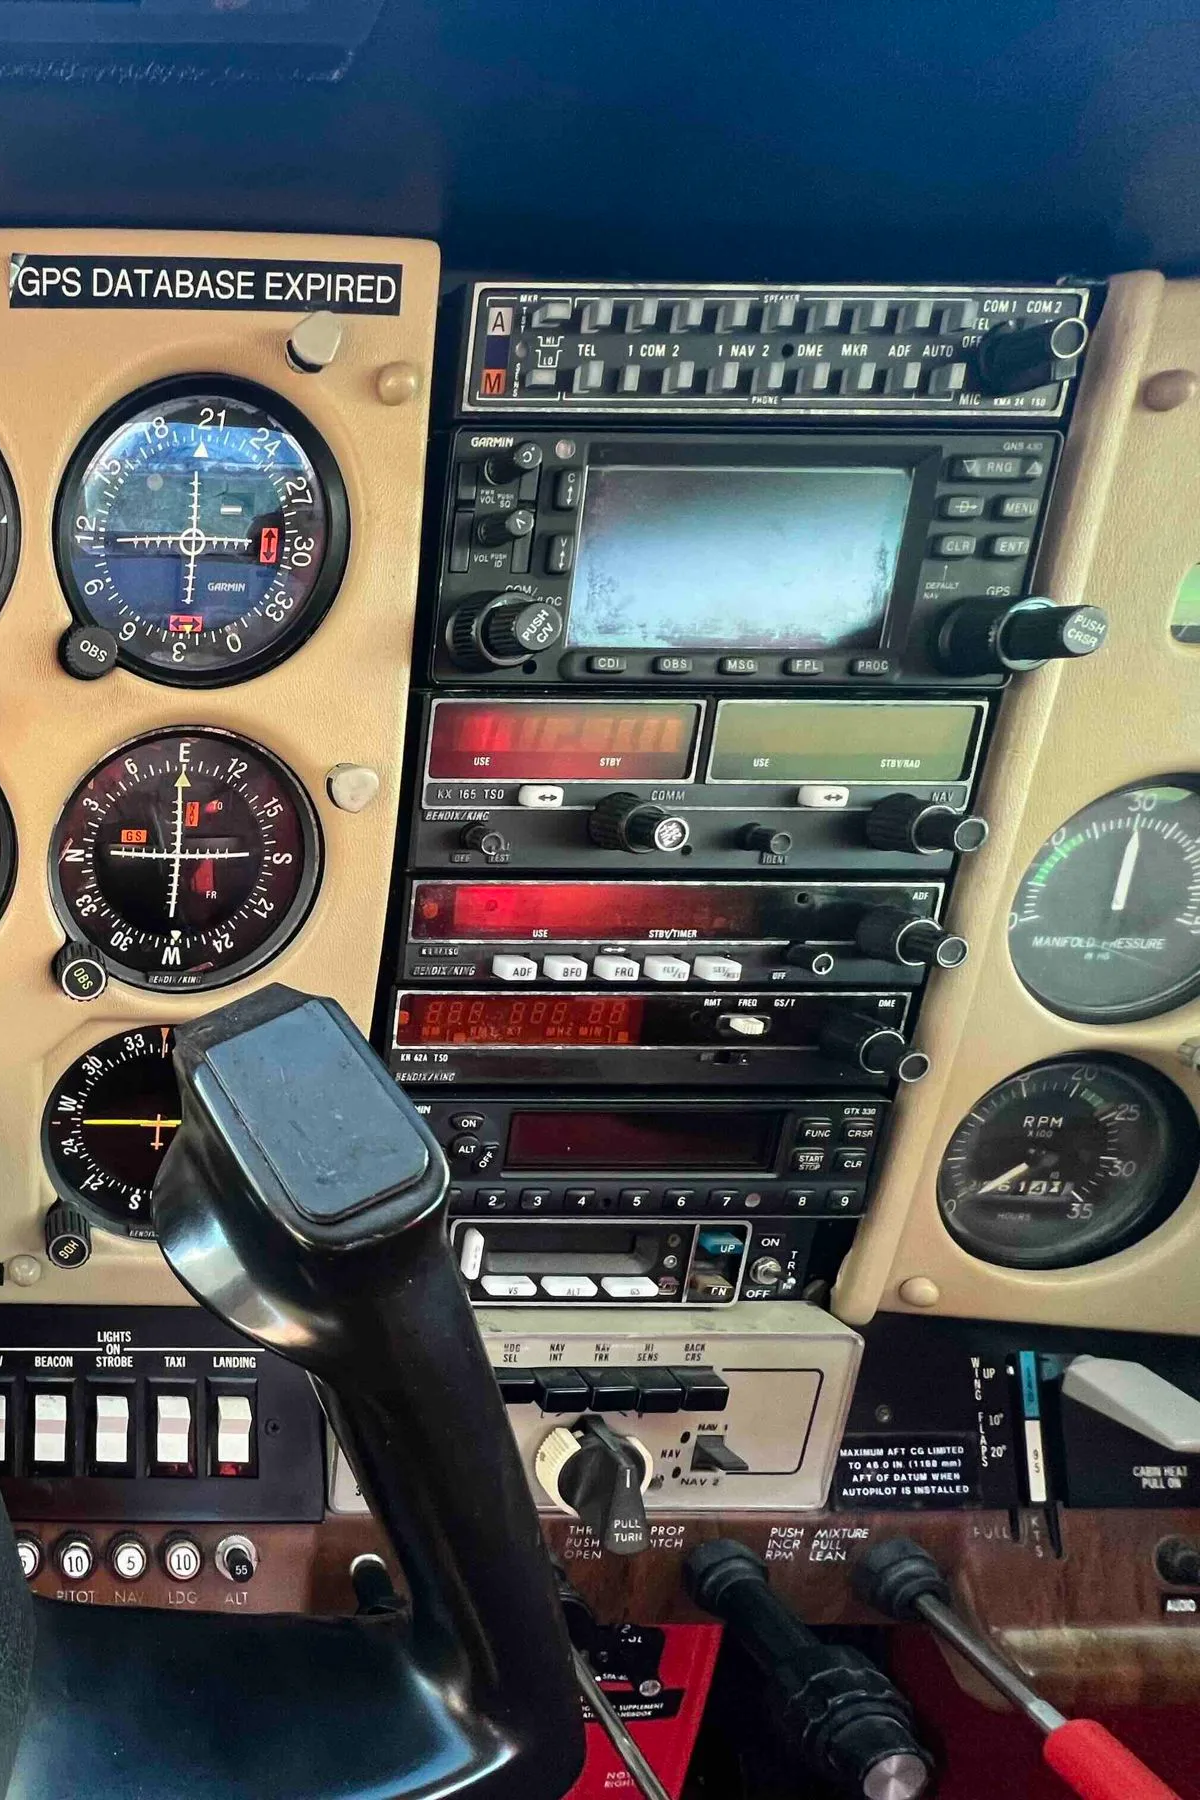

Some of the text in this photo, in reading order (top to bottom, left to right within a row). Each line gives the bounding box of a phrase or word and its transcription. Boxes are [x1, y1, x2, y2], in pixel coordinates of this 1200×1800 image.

[17, 266, 396, 304] GPS DATABASE EXPIRED
[491, 310, 505, 332] A
[962, 336, 983, 349] OFF
[578, 344, 596, 357] TEL
[798, 344, 823, 357] DME
[841, 344, 867, 357] MKR
[888, 344, 912, 357] ADF
[922, 344, 953, 357] AUTO
[959, 394, 981, 406] MIC
[200, 407, 227, 431] 21
[470, 436, 514, 447] GARMIN
[987, 462, 1013, 473] RNG
[1005, 502, 1035, 514] MENU
[74, 515, 97, 544] 12
[291, 535, 315, 567] 30
[207, 581, 246, 593] GARMIN
[986, 586, 1011, 596] GPS
[521, 609, 549, 642] PUSH
[1073, 614, 1106, 634] PUSH
[1067, 628, 1098, 647] CRSR
[79, 639, 108, 663] OBS
[598, 658, 620, 668] CDI
[663, 658, 687, 669] OBS
[727, 659, 755, 670] MSG
[795, 660, 819, 671] FPL
[858, 661, 889, 672] PROC
[473, 757, 491, 766] USE
[600, 757, 622, 767] STBY
[753, 758, 770, 767] USE
[227, 757, 248, 779] 12
[651, 790, 686, 800] COMM
[931, 792, 954, 802] NAV
[1127, 793, 1157, 813] 30
[913, 891, 929, 900] ADF
[75, 893, 98, 917] 33
[253, 898, 275, 919] 21
[532, 929, 548, 938] USE
[649, 929, 698, 938] STBY/TIMER
[1032, 936, 1096, 949] MANIFOLD
[512, 967, 533, 977] ADF
[562, 967, 582, 978] BFO
[614, 967, 634, 978] FRQ
[72, 966, 94, 991] OBS
[704, 999, 721, 1007] RMT
[738, 999, 758, 1007] FREQ
[878, 1000, 896, 1008] DME
[123, 1033, 146, 1051] 33
[843, 1107, 877, 1115] GTX 330
[1114, 1103, 1141, 1122] 25
[461, 1119, 477, 1128] ON
[1023, 1115, 1064, 1128] RPM
[805, 1129, 831, 1137] FUNC
[847, 1129, 873, 1138] CRSR
[458, 1145, 477, 1154] ALT
[479, 1151, 494, 1168] OFF
[799, 1155, 824, 1163] START
[844, 1160, 863, 1168] CLR
[488, 1196, 498, 1206] 2
[677, 1196, 686, 1207] 6
[840, 1197, 850, 1207] 9
[1066, 1203, 1094, 1220] 35
[761, 1238, 781, 1247] ON
[720, 1244, 736, 1253] UP
[746, 1289, 771, 1299] OFF
[97, 1330, 132, 1343] LIGHTS
[105, 1343, 121, 1355] ON
[550, 1343, 565, 1353] NAV
[684, 1343, 706, 1352] BACK
[34, 1355, 74, 1368] BEACON
[95, 1356, 134, 1368] STROBE
[164, 1356, 186, 1369] TAXI
[213, 1356, 257, 1369] LANDING
[503, 1353, 518, 1363] SEL
[637, 1353, 659, 1362] SENS
[983, 1368, 996, 1379] UP
[660, 1449, 681, 1459] NAV
[840, 1446, 964, 1457] MAXIMUM AFT CG LIMITED
[852, 1473, 960, 1483] AFT OF DATUM WHEN
[842, 1485, 970, 1496] AUTOPILOT IS INSTALLED
[614, 1519, 642, 1529] PULL
[569, 1525, 593, 1535] THR
[650, 1526, 685, 1535] PROP
[770, 1527, 805, 1537] PUSH
[814, 1528, 869, 1539] MIXTURE
[565, 1537, 600, 1548] PUSH
[614, 1532, 643, 1542] TURN
[768, 1539, 801, 1549] INCR
[811, 1540, 842, 1550] PULL
[564, 1550, 602, 1560] OPEN
[765, 1551, 795, 1561] RPM
[809, 1551, 847, 1561] LEAN
[68, 1554, 84, 1572] 10
[235, 1564, 248, 1576] 55
[57, 1590, 95, 1604] PITOT
[115, 1591, 145, 1604] NAV
[168, 1591, 197, 1605] LDG
[224, 1591, 249, 1605] ALT
